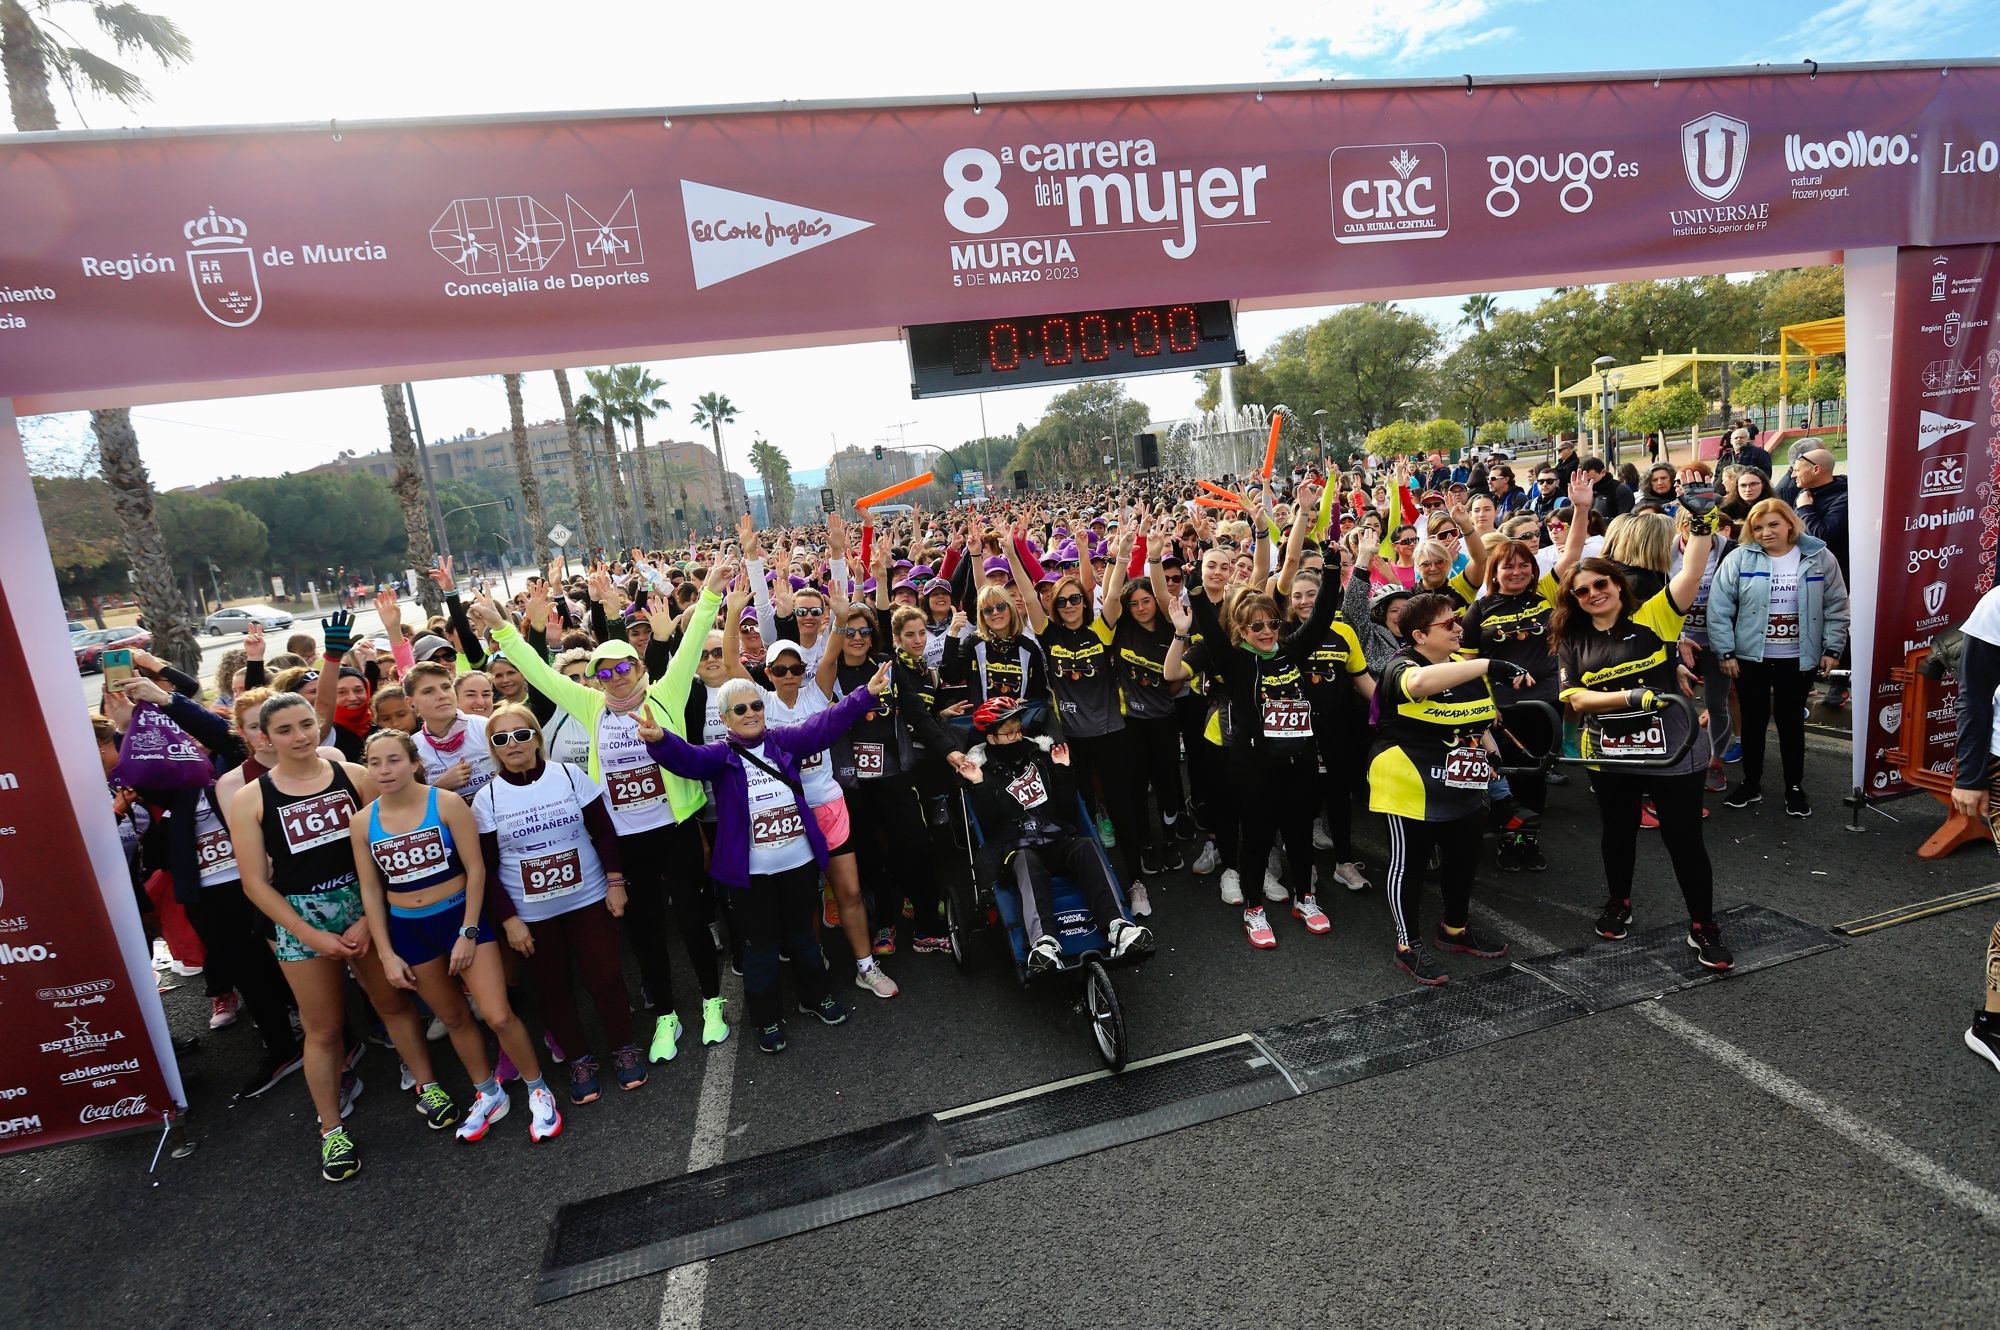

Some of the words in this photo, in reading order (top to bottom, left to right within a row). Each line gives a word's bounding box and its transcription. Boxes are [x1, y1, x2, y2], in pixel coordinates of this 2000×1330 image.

[1019, 139, 1156, 172] carrera
[1941, 140, 2000, 178] LaO
[1486, 150, 1639, 217] gougo.es
[1791, 175, 1822, 187] natural
[1342, 176, 1436, 220] CRC
[1791, 188, 1819, 200] frozen
[1819, 186, 1849, 200] yogurt.
[1066, 165, 1267, 259] mujer
[1669, 203, 1769, 227] UNIVERSAE
[692, 221, 714, 242] El
[714, 220, 764, 241] Corte
[764, 212, 832, 246] Inglés
[1344, 223, 1365, 233] CAJA
[1367, 221, 1395, 232] RURAL
[1396, 219, 1436, 230] CENTRAL
[1672, 224, 1706, 237] Instituto
[1708, 222, 1737, 235] Superior
[1739, 222, 1753, 232] de
[1756, 221, 1768, 231] FP
[81, 253, 175, 282] Región
[262, 247, 294, 266] de
[302, 242, 387, 264] Murcia
[951, 239, 1076, 270] MURCIA
[444, 276, 539, 297] Concejalía
[544, 275, 566, 291] de
[571, 269, 650, 290] Deportes
[953, 275, 963, 287] 5
[967, 272, 985, 287] DE
[989, 270, 1042, 285] MARZO
[1045, 266, 1080, 281] 2023
[1920, 324, 1942, 333] Región
[1924, 467, 1962, 487] CRC
[1904, 505, 1975, 531] LaOpinión
[554, 531, 566, 540] 30
[1907, 544, 1963, 573] gougo.es
[1265, 711, 1308, 726] 4787
[1424, 708, 1470, 718] ZANCADAS
[1470, 706, 1490, 716] SOBRE
[1927, 707, 1955, 719] ESTRE
[1448, 760, 1489, 778] 4793
[615, 778, 656, 800] 296
[288, 804, 353, 836] 1611
[512, 814, 579, 839] COMPAÑERAS
[526, 812, 539, 824] MÍ
[754, 815, 804, 839] 2482
[379, 843, 442, 871] 2888
[311, 872, 355, 891] NIKE
[530, 864, 575, 888] 928
[40, 1030, 126, 1053] ESTRELLA
[60, 1058, 140, 1081] cableworld
[92, 1078, 117, 1088] fibra
[80, 1094, 148, 1124] Coca-Cola
